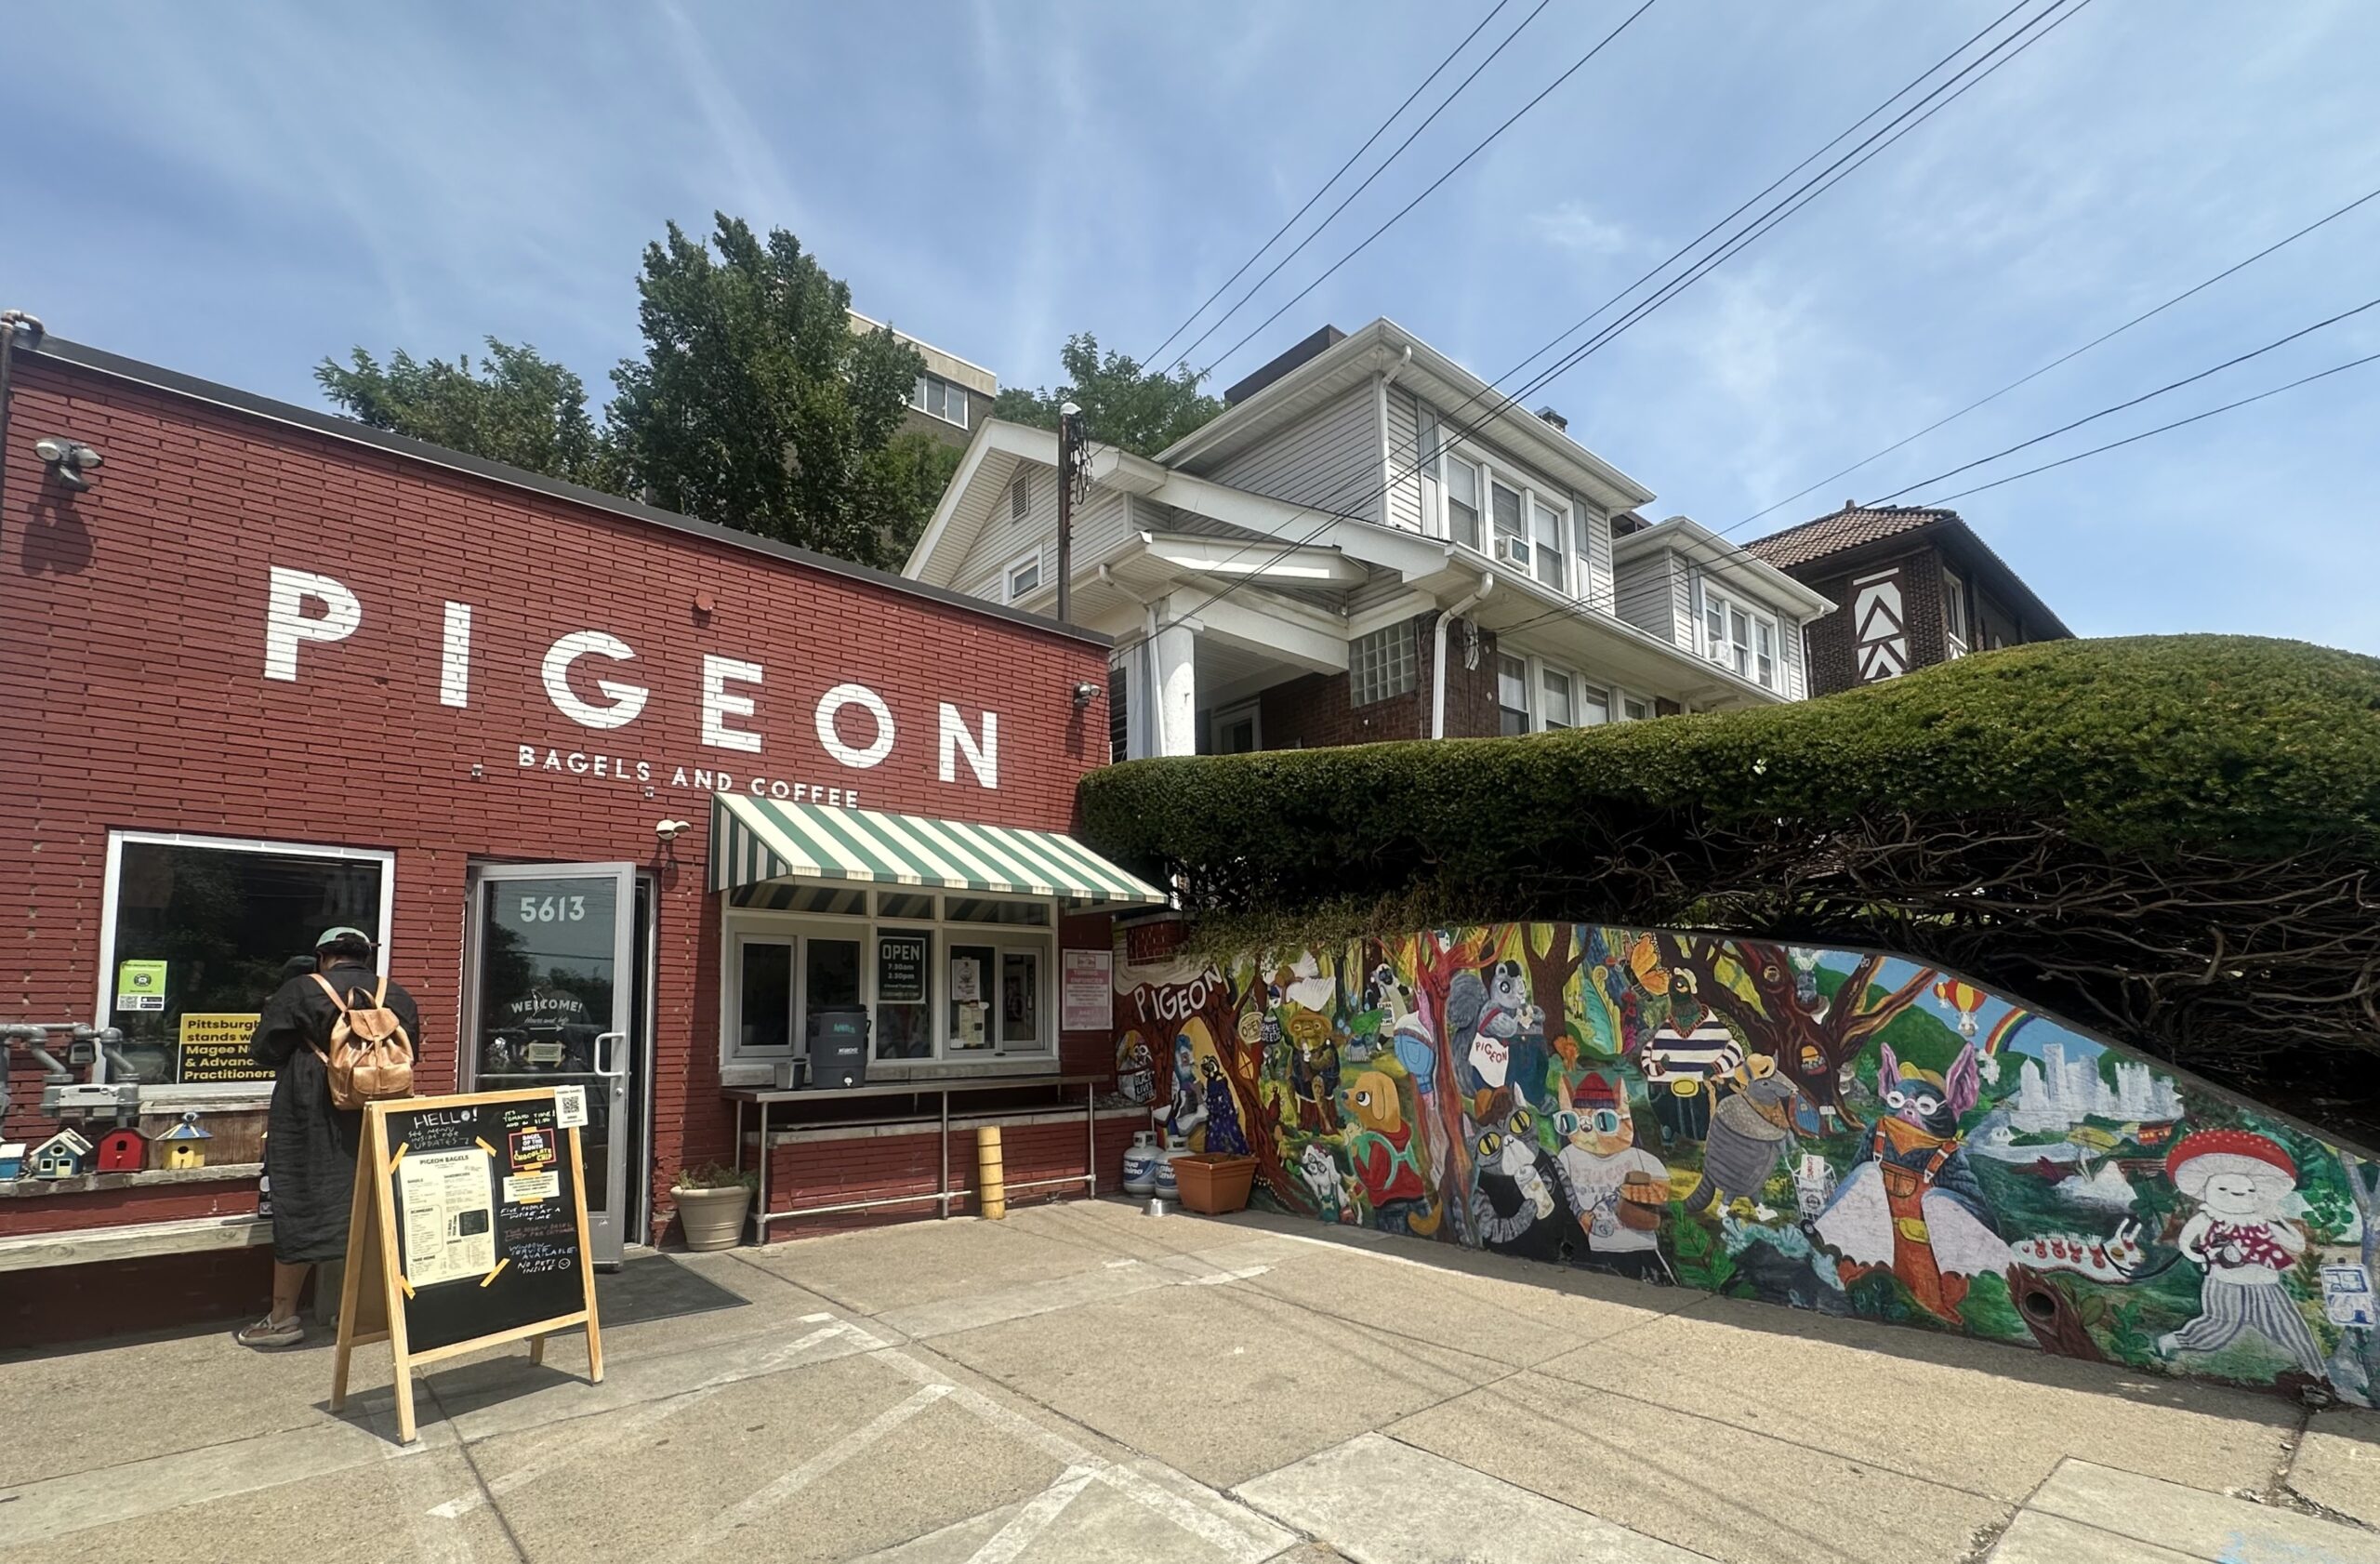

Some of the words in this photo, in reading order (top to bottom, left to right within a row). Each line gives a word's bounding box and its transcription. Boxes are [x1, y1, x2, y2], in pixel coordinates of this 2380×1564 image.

[264, 565, 998, 789] PIGEON
[518, 745, 651, 782] BAGELS
[670, 766, 733, 792] AND
[750, 776, 860, 809] COFFEE
[520, 895, 586, 922] 5613
[882, 944, 920, 961] OPEN
[1133, 962, 1223, 1023] PIGEON
[511, 998, 584, 1014] WELCOME!
[187, 1033, 237, 1041] stands
[1262, 1032, 1281, 1042] SEEDS
[186, 1045, 235, 1057] Magee
[1474, 1041, 1508, 1064] PIGEON
[185, 1058, 196, 1067] &
[200, 1057, 256, 1067] Advanc
[184, 1069, 276, 1080] Practitioners
[414, 1107, 478, 1129] HELLO!
[412, 1133, 437, 1143] INSIDE
[414, 1137, 457, 1150] UPDATES
[522, 1144, 544, 1152] MONTH
[513, 1148, 552, 1161] CHOCOLATE
[536, 1153, 552, 1161] CHIP
[419, 1157, 444, 1165] PIGEON
[522, 1246, 577, 1260] AVAILABLE
[518, 1260, 531, 1268] NO
[522, 1265, 556, 1274] INSIDE
